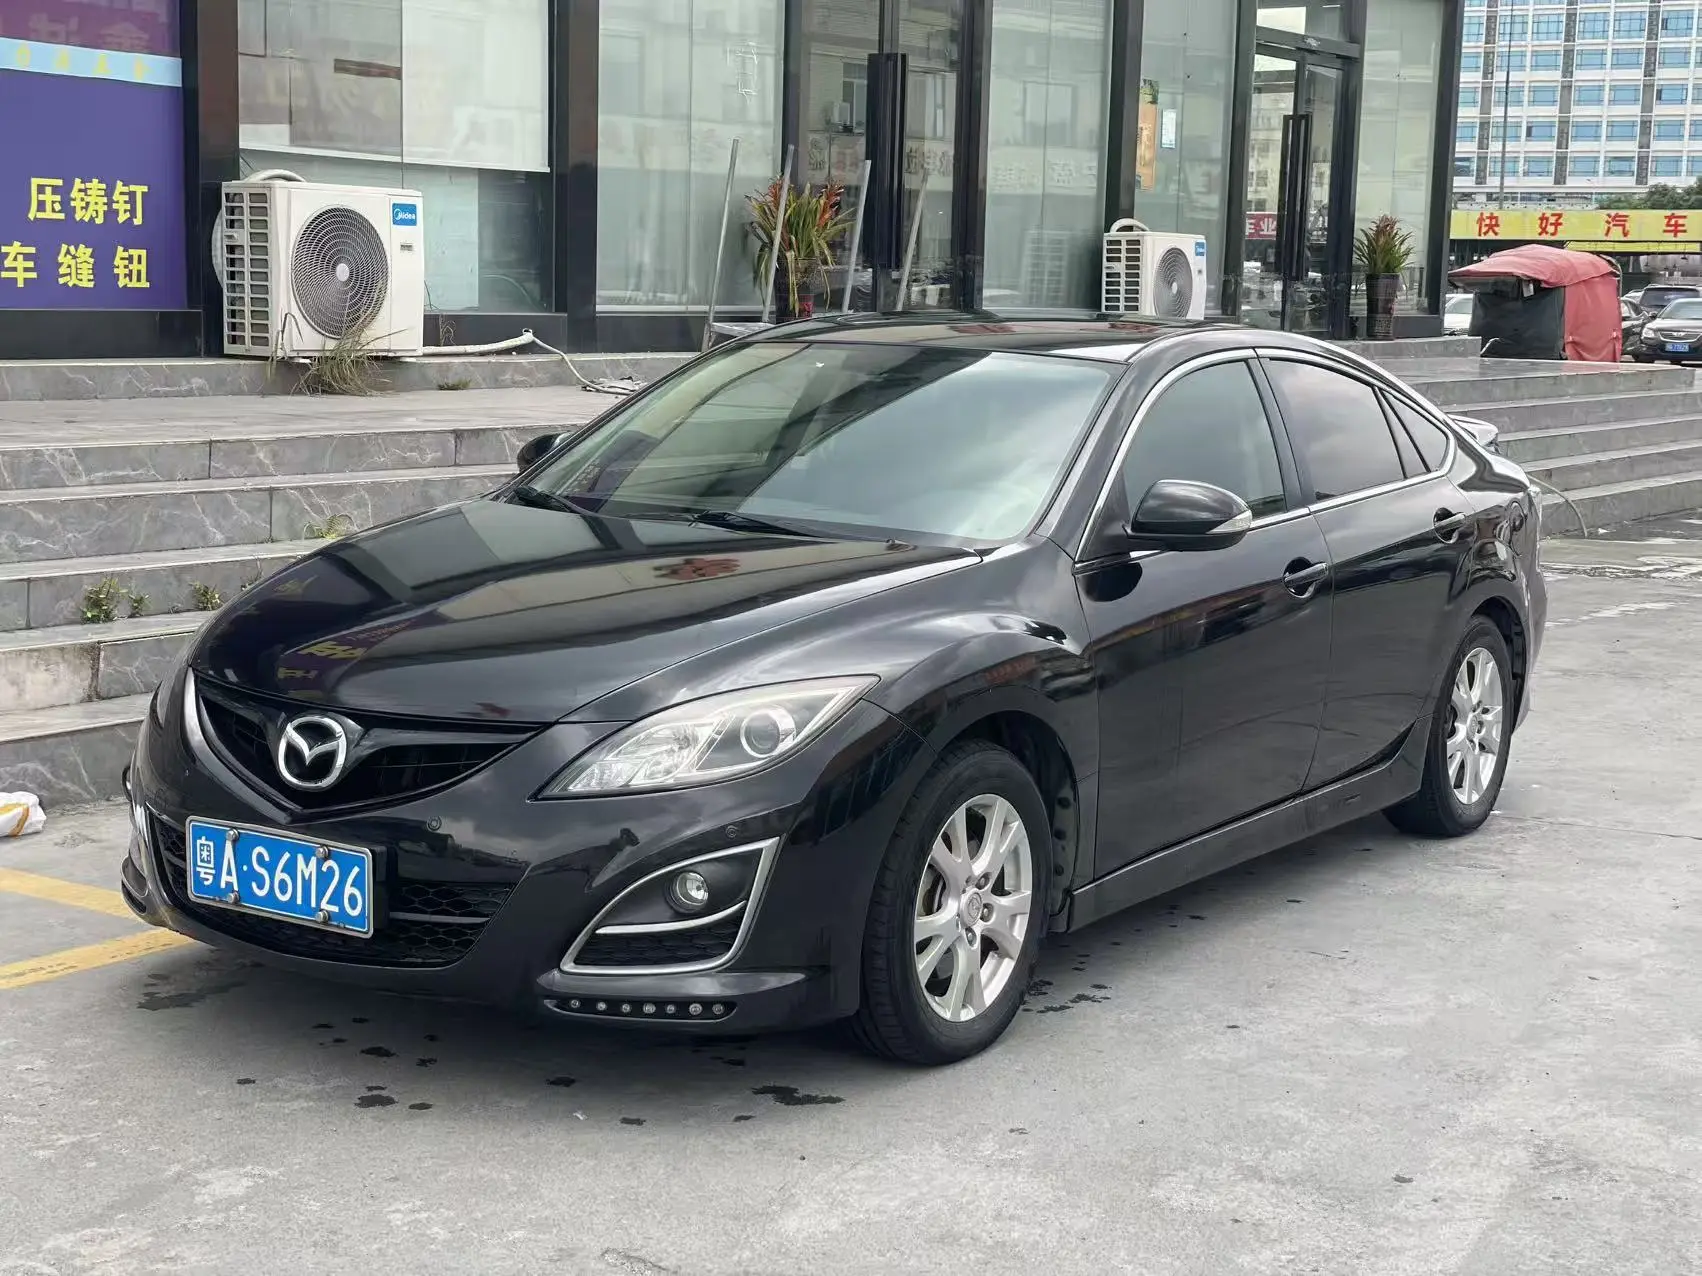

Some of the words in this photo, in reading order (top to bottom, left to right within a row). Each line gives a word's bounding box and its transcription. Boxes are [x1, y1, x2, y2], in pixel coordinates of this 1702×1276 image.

[28, 177, 148, 225] 压铸钉
[0, 241, 150, 289] 车缝钮
